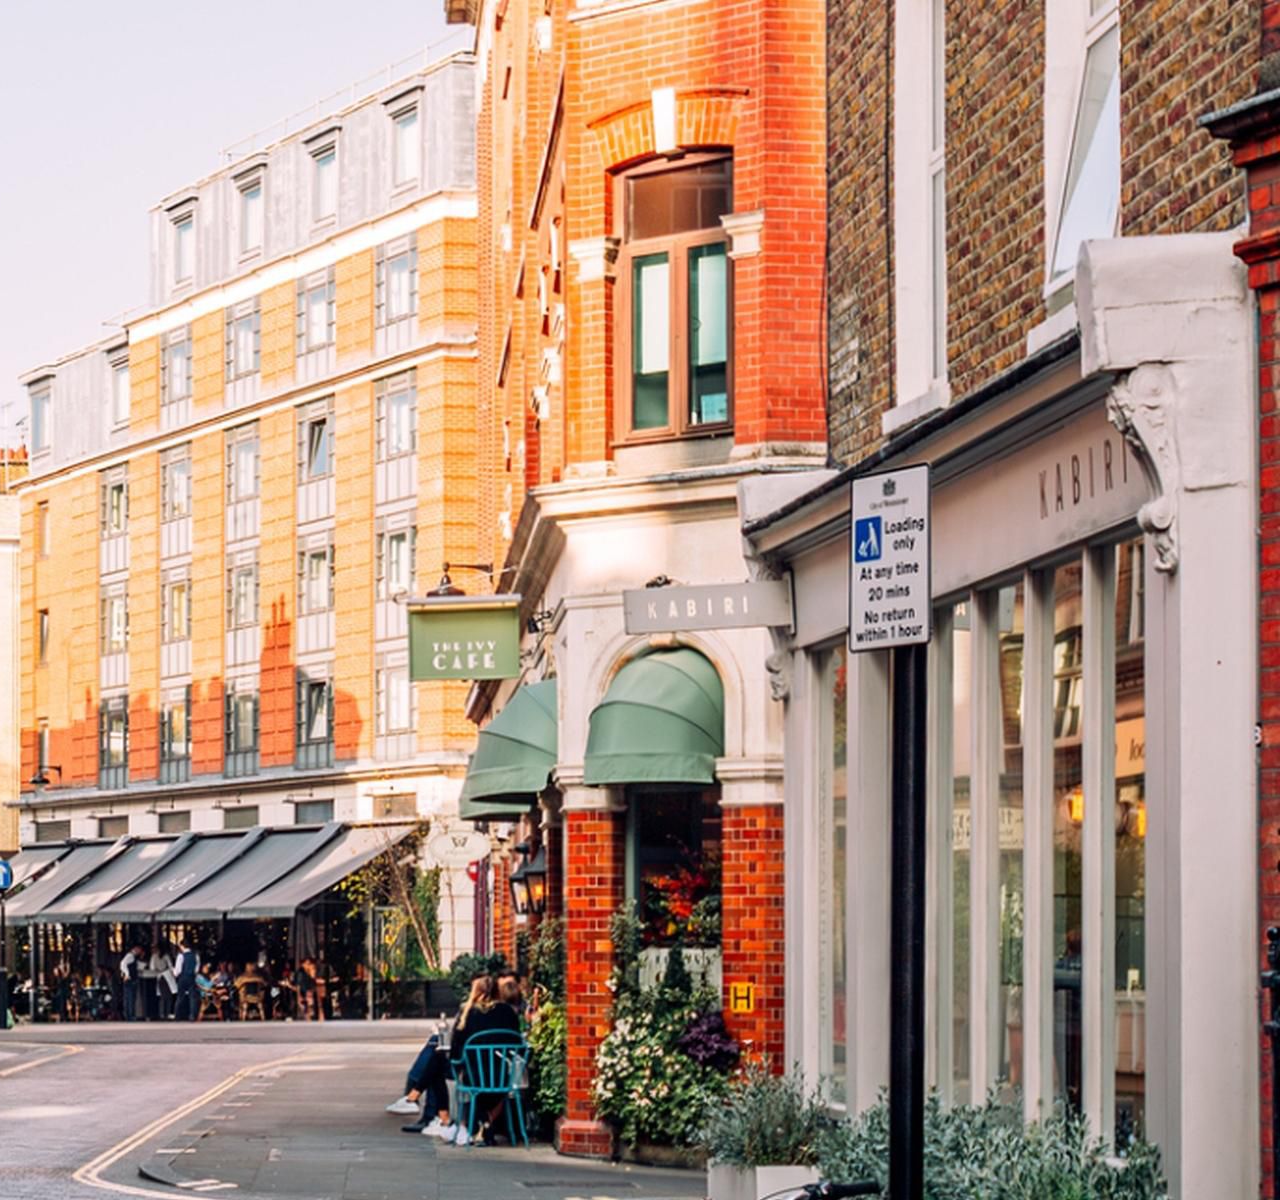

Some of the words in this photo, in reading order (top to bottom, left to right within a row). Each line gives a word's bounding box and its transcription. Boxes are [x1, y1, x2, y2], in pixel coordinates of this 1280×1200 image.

[1038, 434, 1128, 520] KABIRI
[884, 517, 925, 535] Loading
[892, 534, 915, 551] only
[860, 567, 873, 581] At
[874, 566, 893, 580] any
[896, 561, 919, 576] time
[868, 587, 883, 602] 20
[885, 584, 910, 598] mins
[646, 595, 749, 620] KABIRI
[864, 610, 879, 625] No
[882, 606, 915, 623] return
[856, 628, 888, 643] within
[890, 625, 895, 639] 1
[898, 622, 923, 637] hour
[432, 641, 461, 652] THE
[466, 639, 497, 651] IVY
[734, 985, 751, 1009] H
